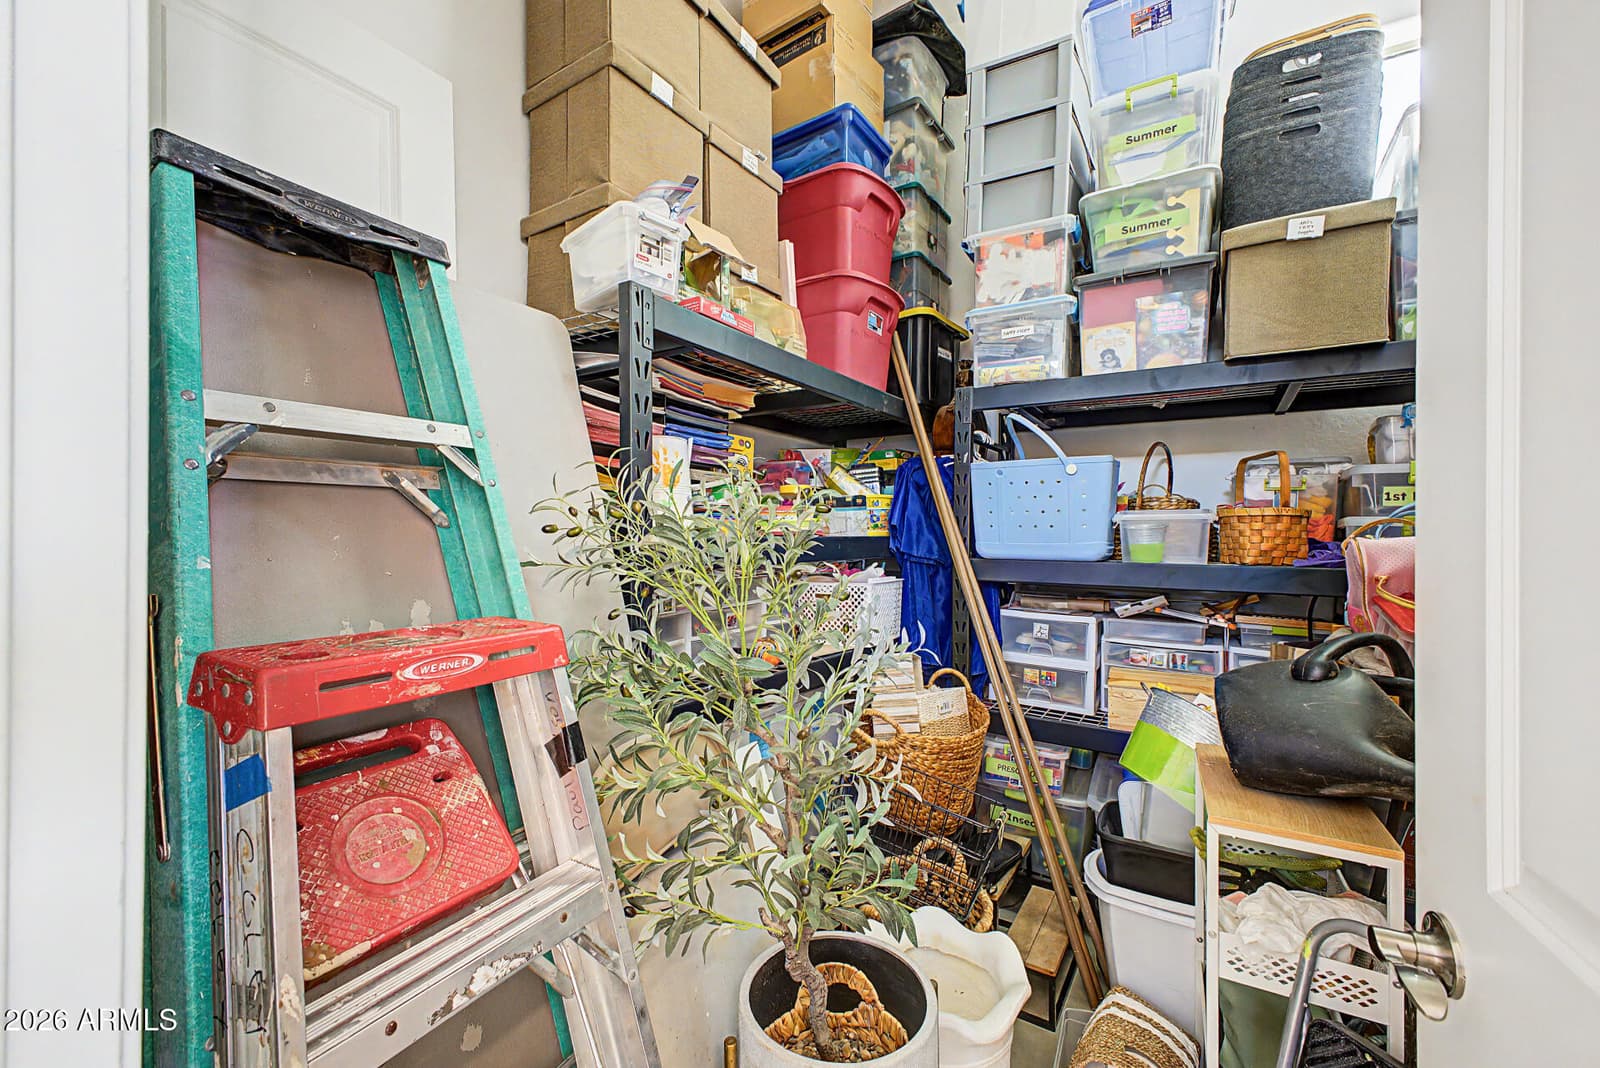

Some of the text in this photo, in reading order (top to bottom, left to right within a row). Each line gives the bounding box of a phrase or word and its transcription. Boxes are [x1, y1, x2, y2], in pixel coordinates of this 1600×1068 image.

[1125, 124, 1178, 145] Summer
[1121, 217, 1173, 235] Summer
[1384, 491, 1408, 501] 1st
[420, 657, 470, 674] WERNER
[1007, 813, 1037, 828] Insec
